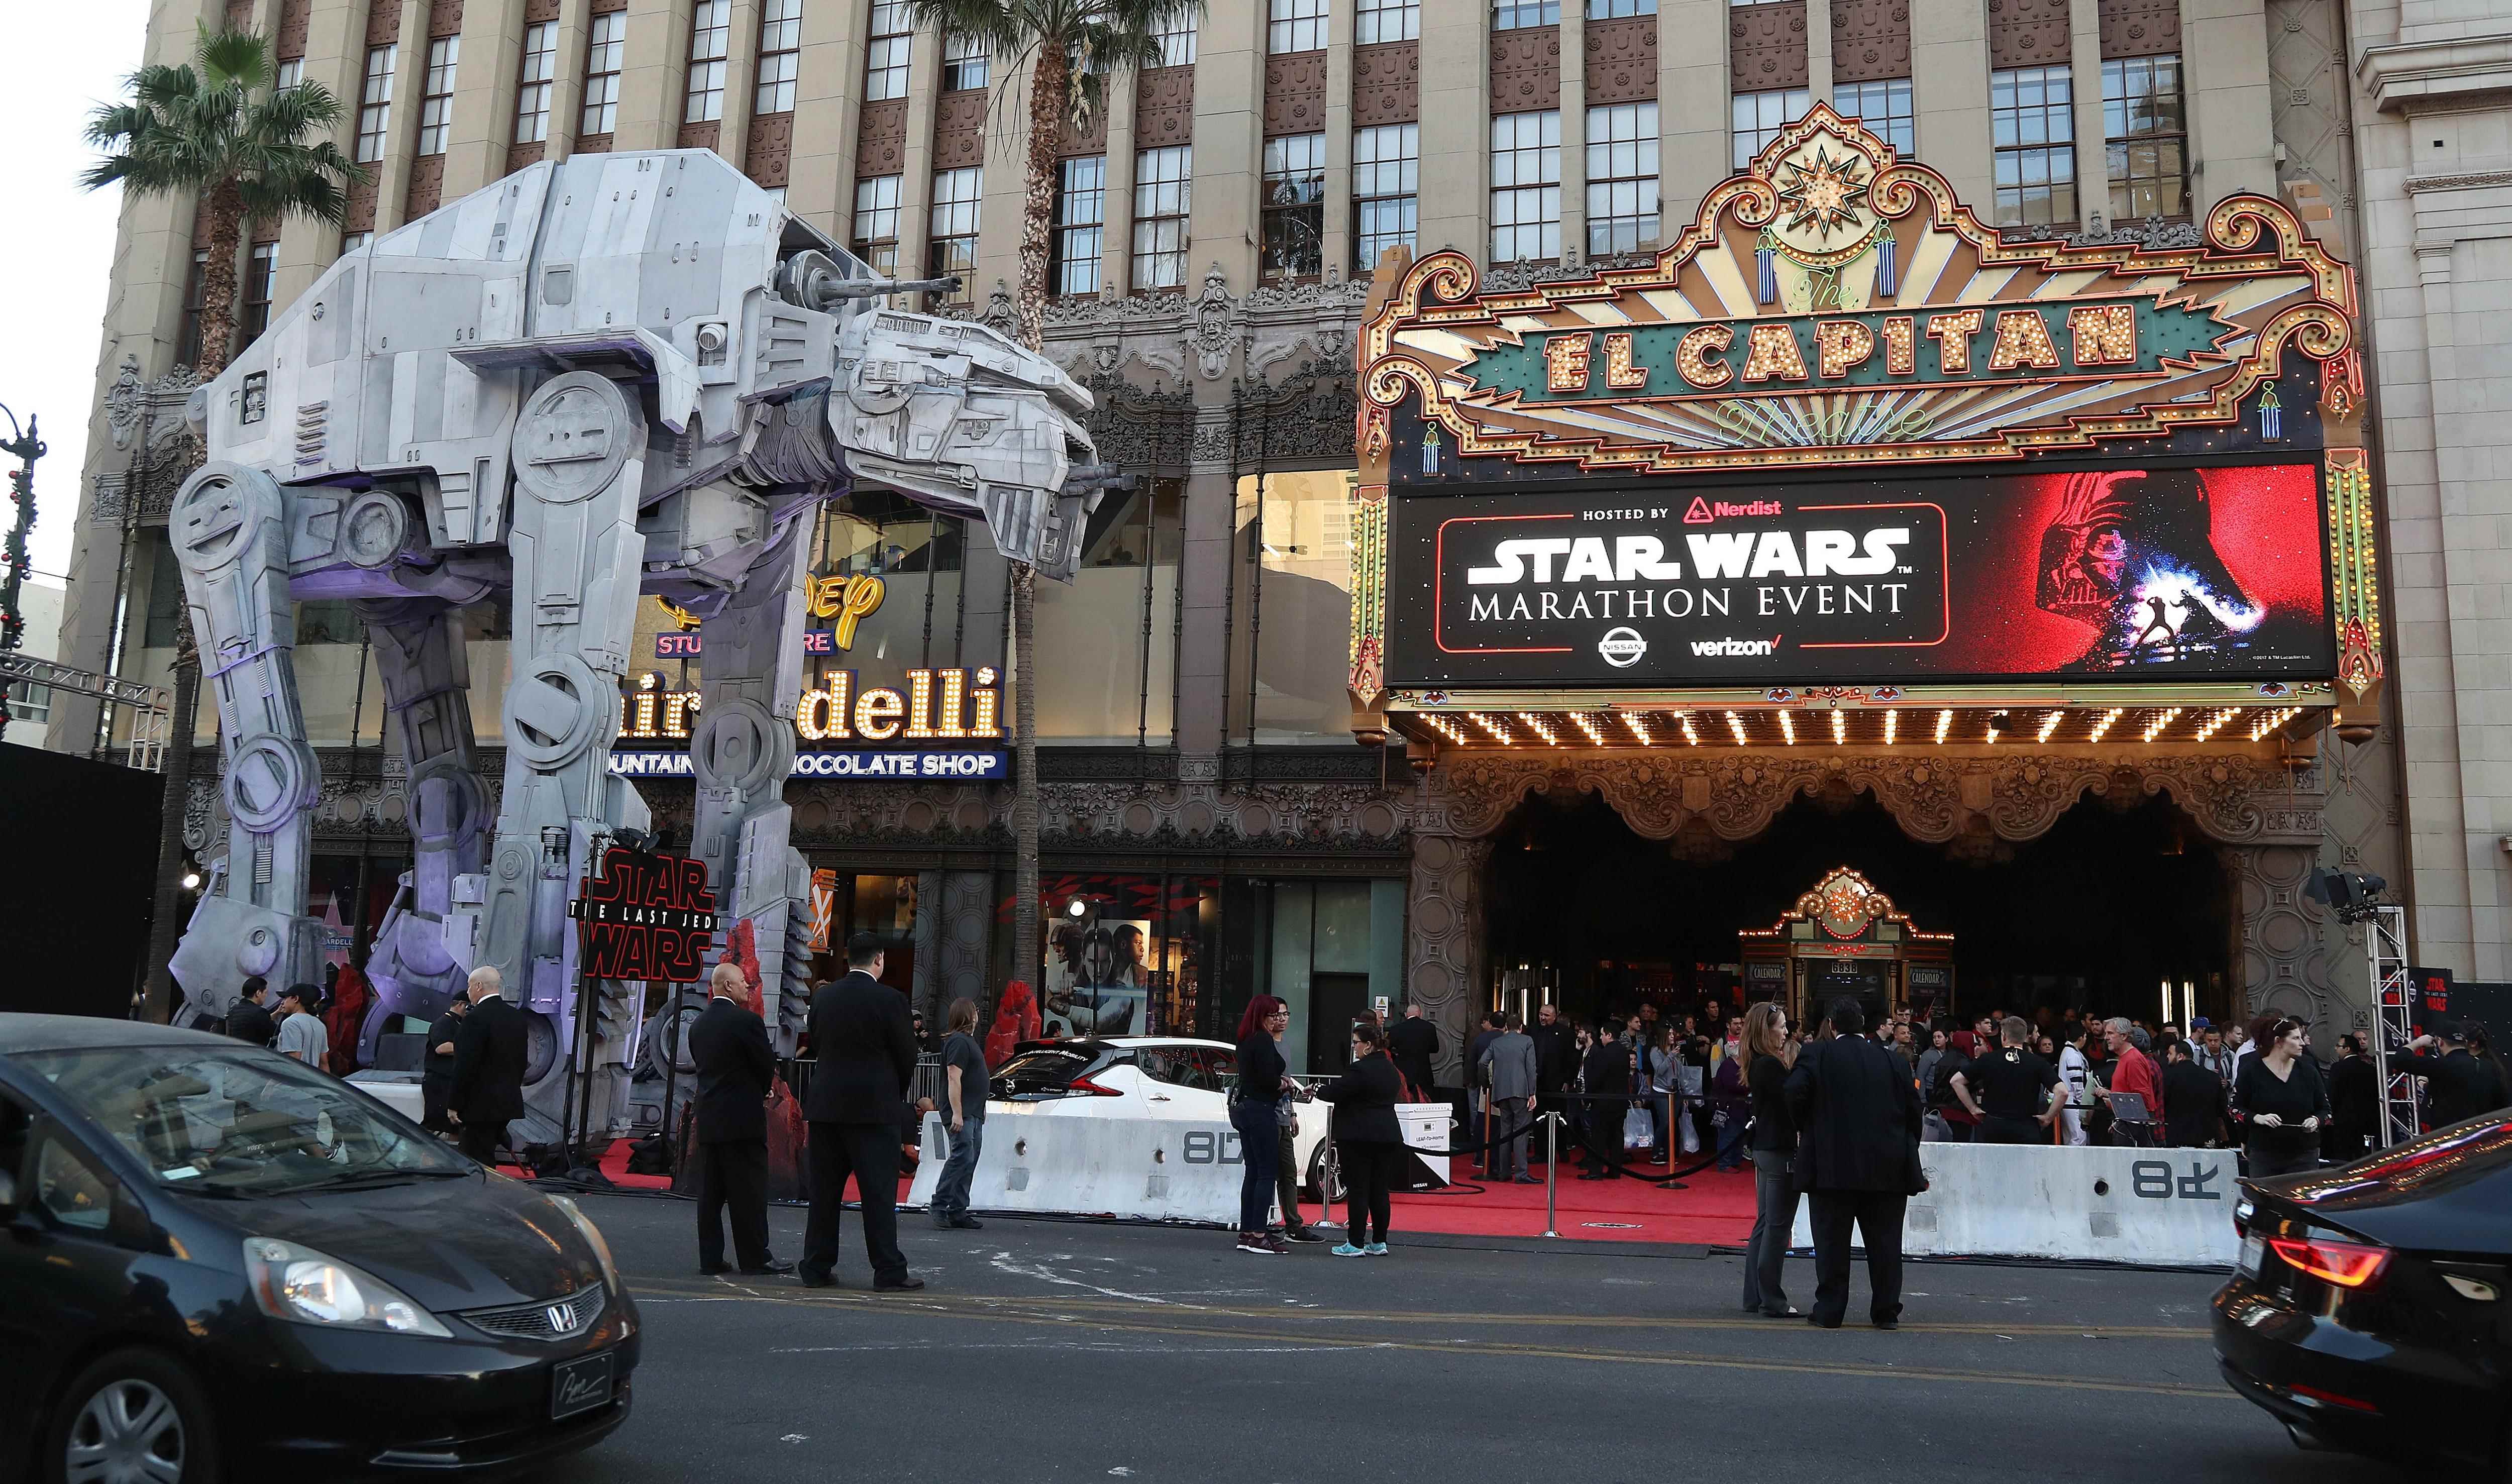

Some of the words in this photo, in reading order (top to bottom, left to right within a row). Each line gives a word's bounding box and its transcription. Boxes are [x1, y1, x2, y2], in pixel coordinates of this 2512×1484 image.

[1789, 268, 1859, 308] The
[1542, 331, 1648, 392] EL
[1676, 303, 2137, 390] CAPITAN
[1715, 399, 1934, 444] Theatre
[1583, 508, 1644, 521] HOSTED
[1650, 507, 1668, 519] BY
[1714, 500, 1782, 516] Nerdist
[1468, 535, 1681, 585] STAR
[1685, 527, 1910, 579] WARS
[1468, 587, 1731, 621] MARATHON
[1757, 583, 1908, 616] EVENT
[658, 635, 701, 655] STU
[1603, 643, 1642, 651] NISSAN
[1690, 637, 1771, 657] verizon
[617, 667, 1001, 740] irdelli
[922, 755, 996, 775] SHOP
[581, 847, 715, 912] STAR
[571, 901, 605, 918] TE
[623, 907, 667, 925] LAST
[682, 913, 720, 930] JEDI
[579, 920, 711, 982] WARS
[1754, 968, 1781, 979] CALENDAR
[1832, 963, 1857, 973] 6838
[1912, 972, 1940, 984] CALENDAR
[2426, 977, 2447, 992] STAR
[2427, 997, 2447, 1012] WARS
